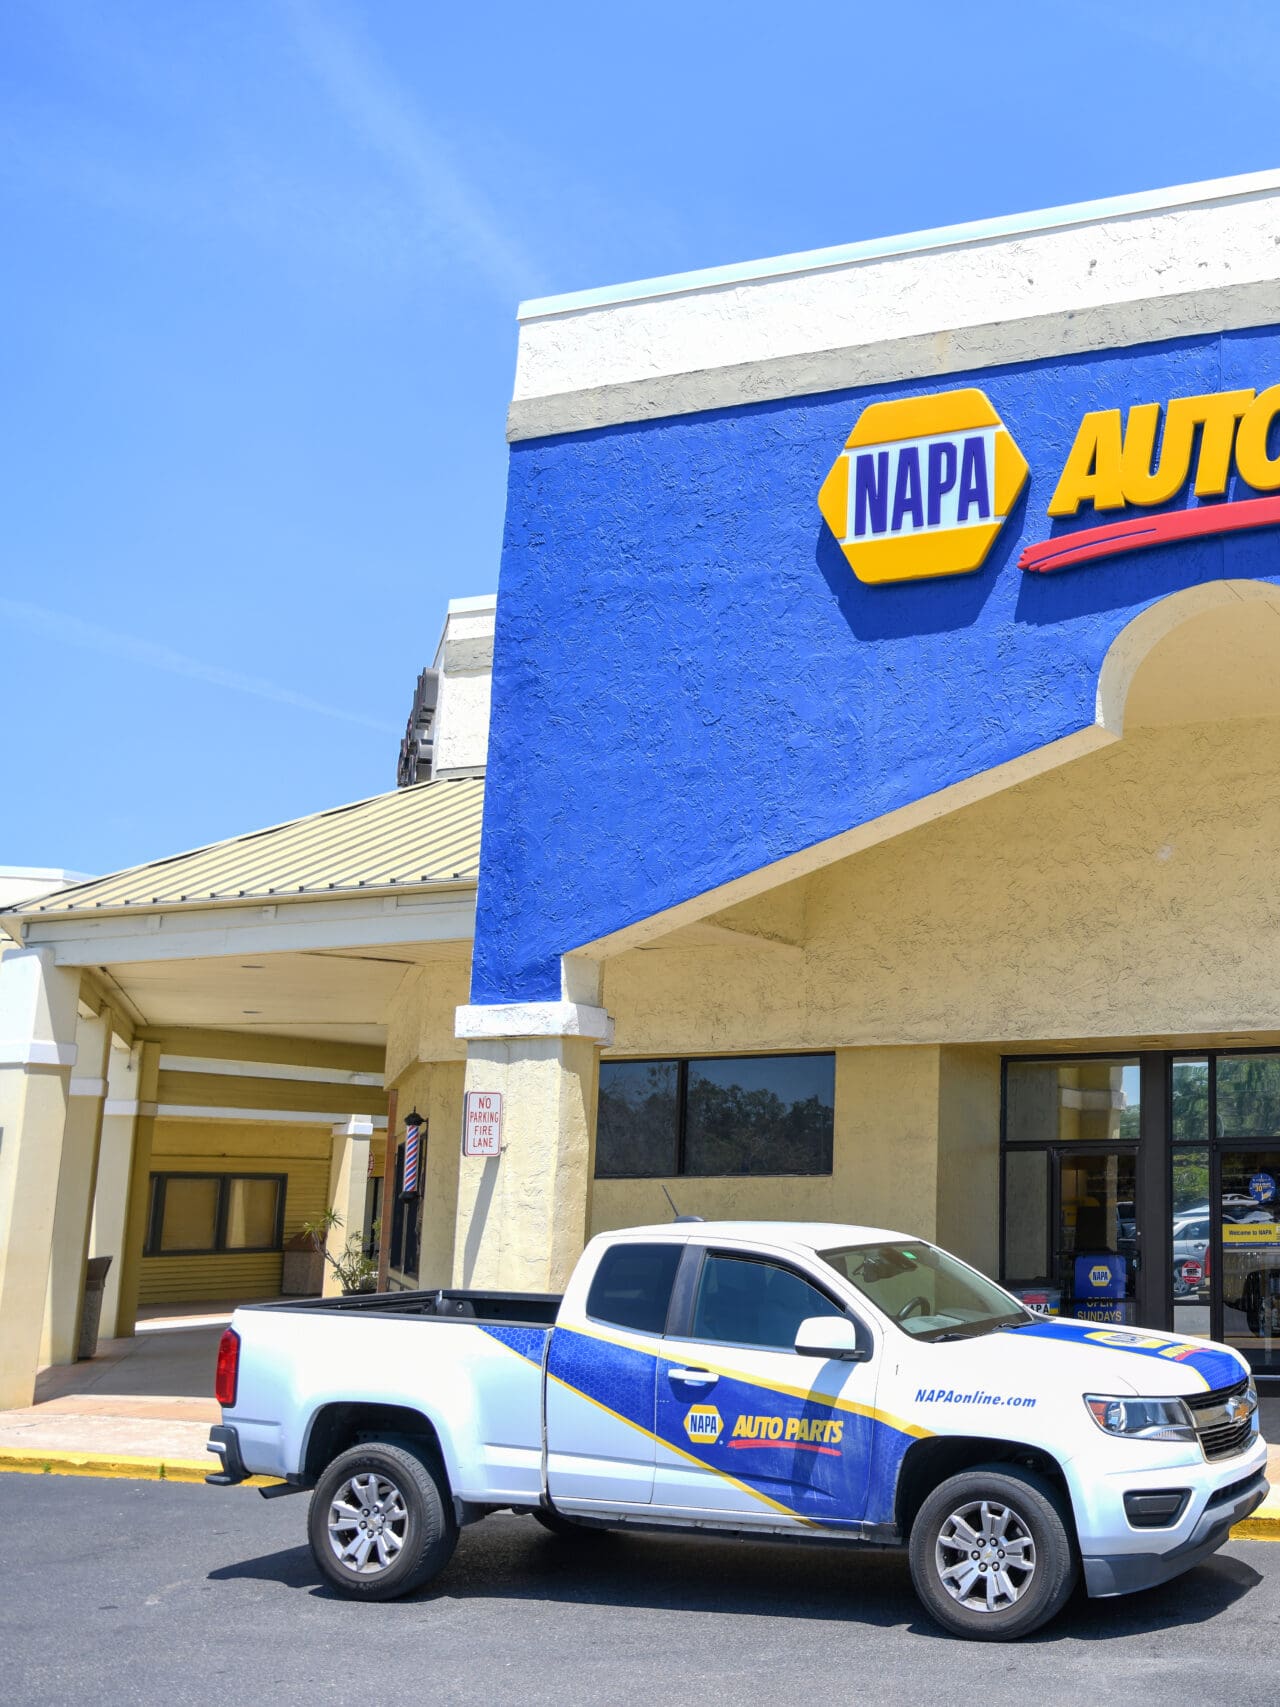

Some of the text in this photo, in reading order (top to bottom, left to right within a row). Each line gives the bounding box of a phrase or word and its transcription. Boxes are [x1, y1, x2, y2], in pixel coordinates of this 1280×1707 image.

[854, 435, 991, 538] NAPA
[478, 1097, 491, 1109] NO
[470, 1112, 499, 1123] PARKING
[474, 1126, 493, 1136] FIRE
[472, 1138, 494, 1148] LANE
[1092, 1271, 1108, 1281] NAPA
[1077, 1310, 1122, 1322] SUNDAYS
[914, 1388, 1036, 1408] NAPAonline.com
[689, 1414, 844, 1444] NAPA AUTO PARTS
